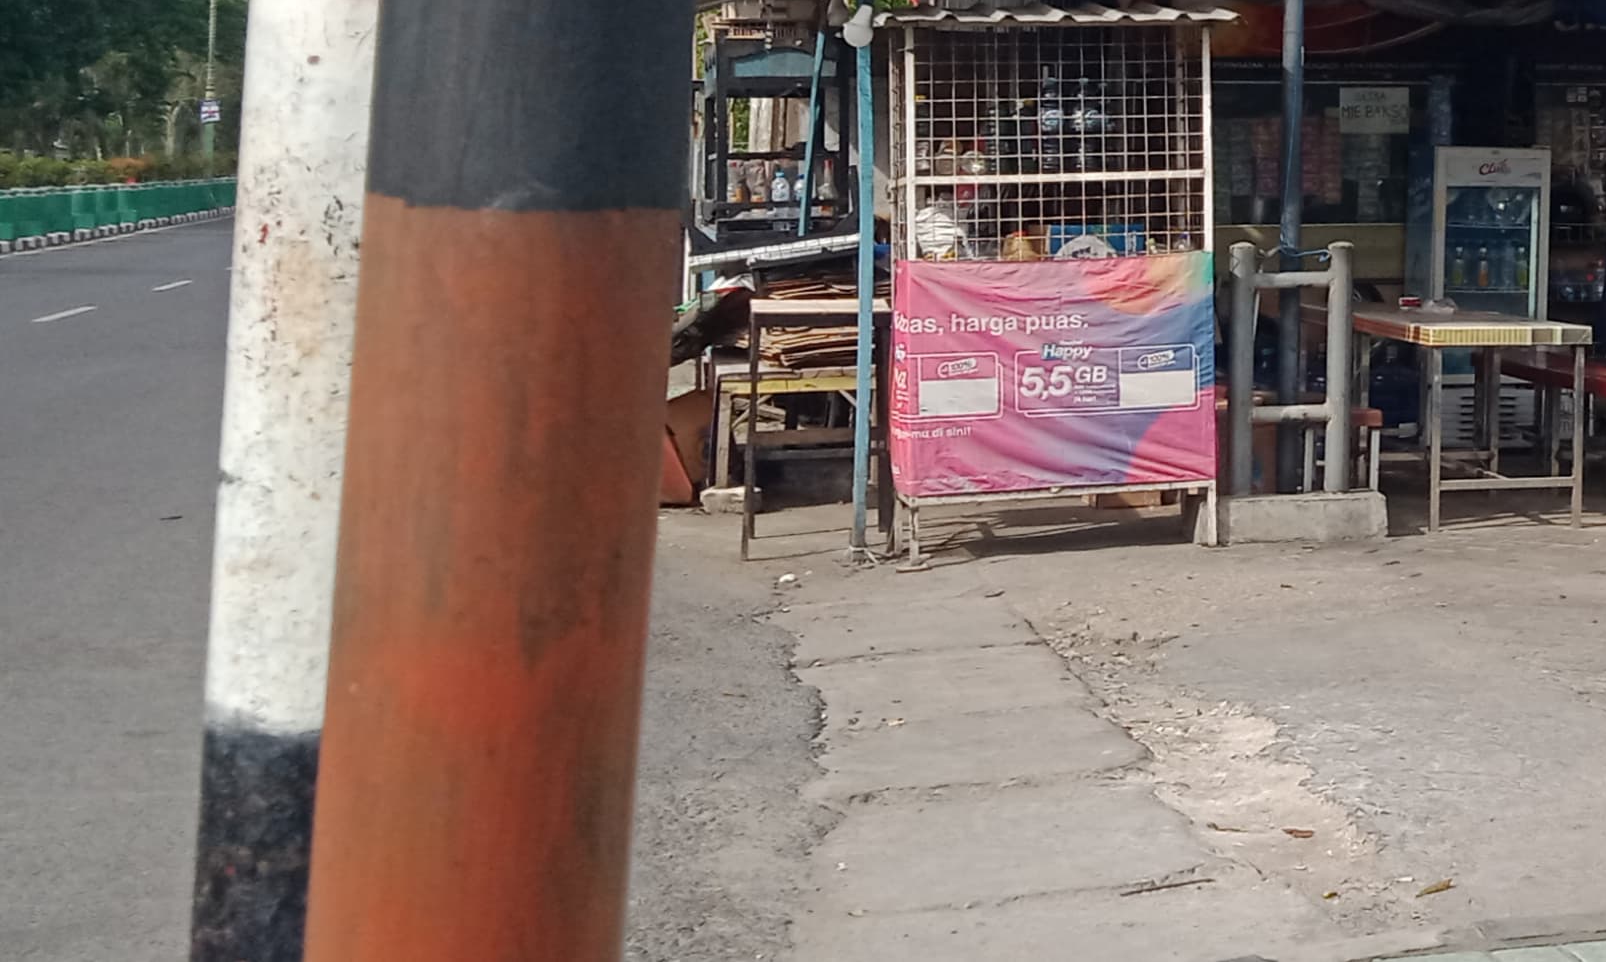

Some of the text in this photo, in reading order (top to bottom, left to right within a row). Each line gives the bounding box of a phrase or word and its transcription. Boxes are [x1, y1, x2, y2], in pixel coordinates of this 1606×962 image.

[951, 313, 1018, 336] harga
[1025, 313, 1089, 335] puas.
[1041, 342, 1093, 361] Happy
[1020, 366, 1073, 400] 5,5
[1074, 365, 1108, 384] GB
